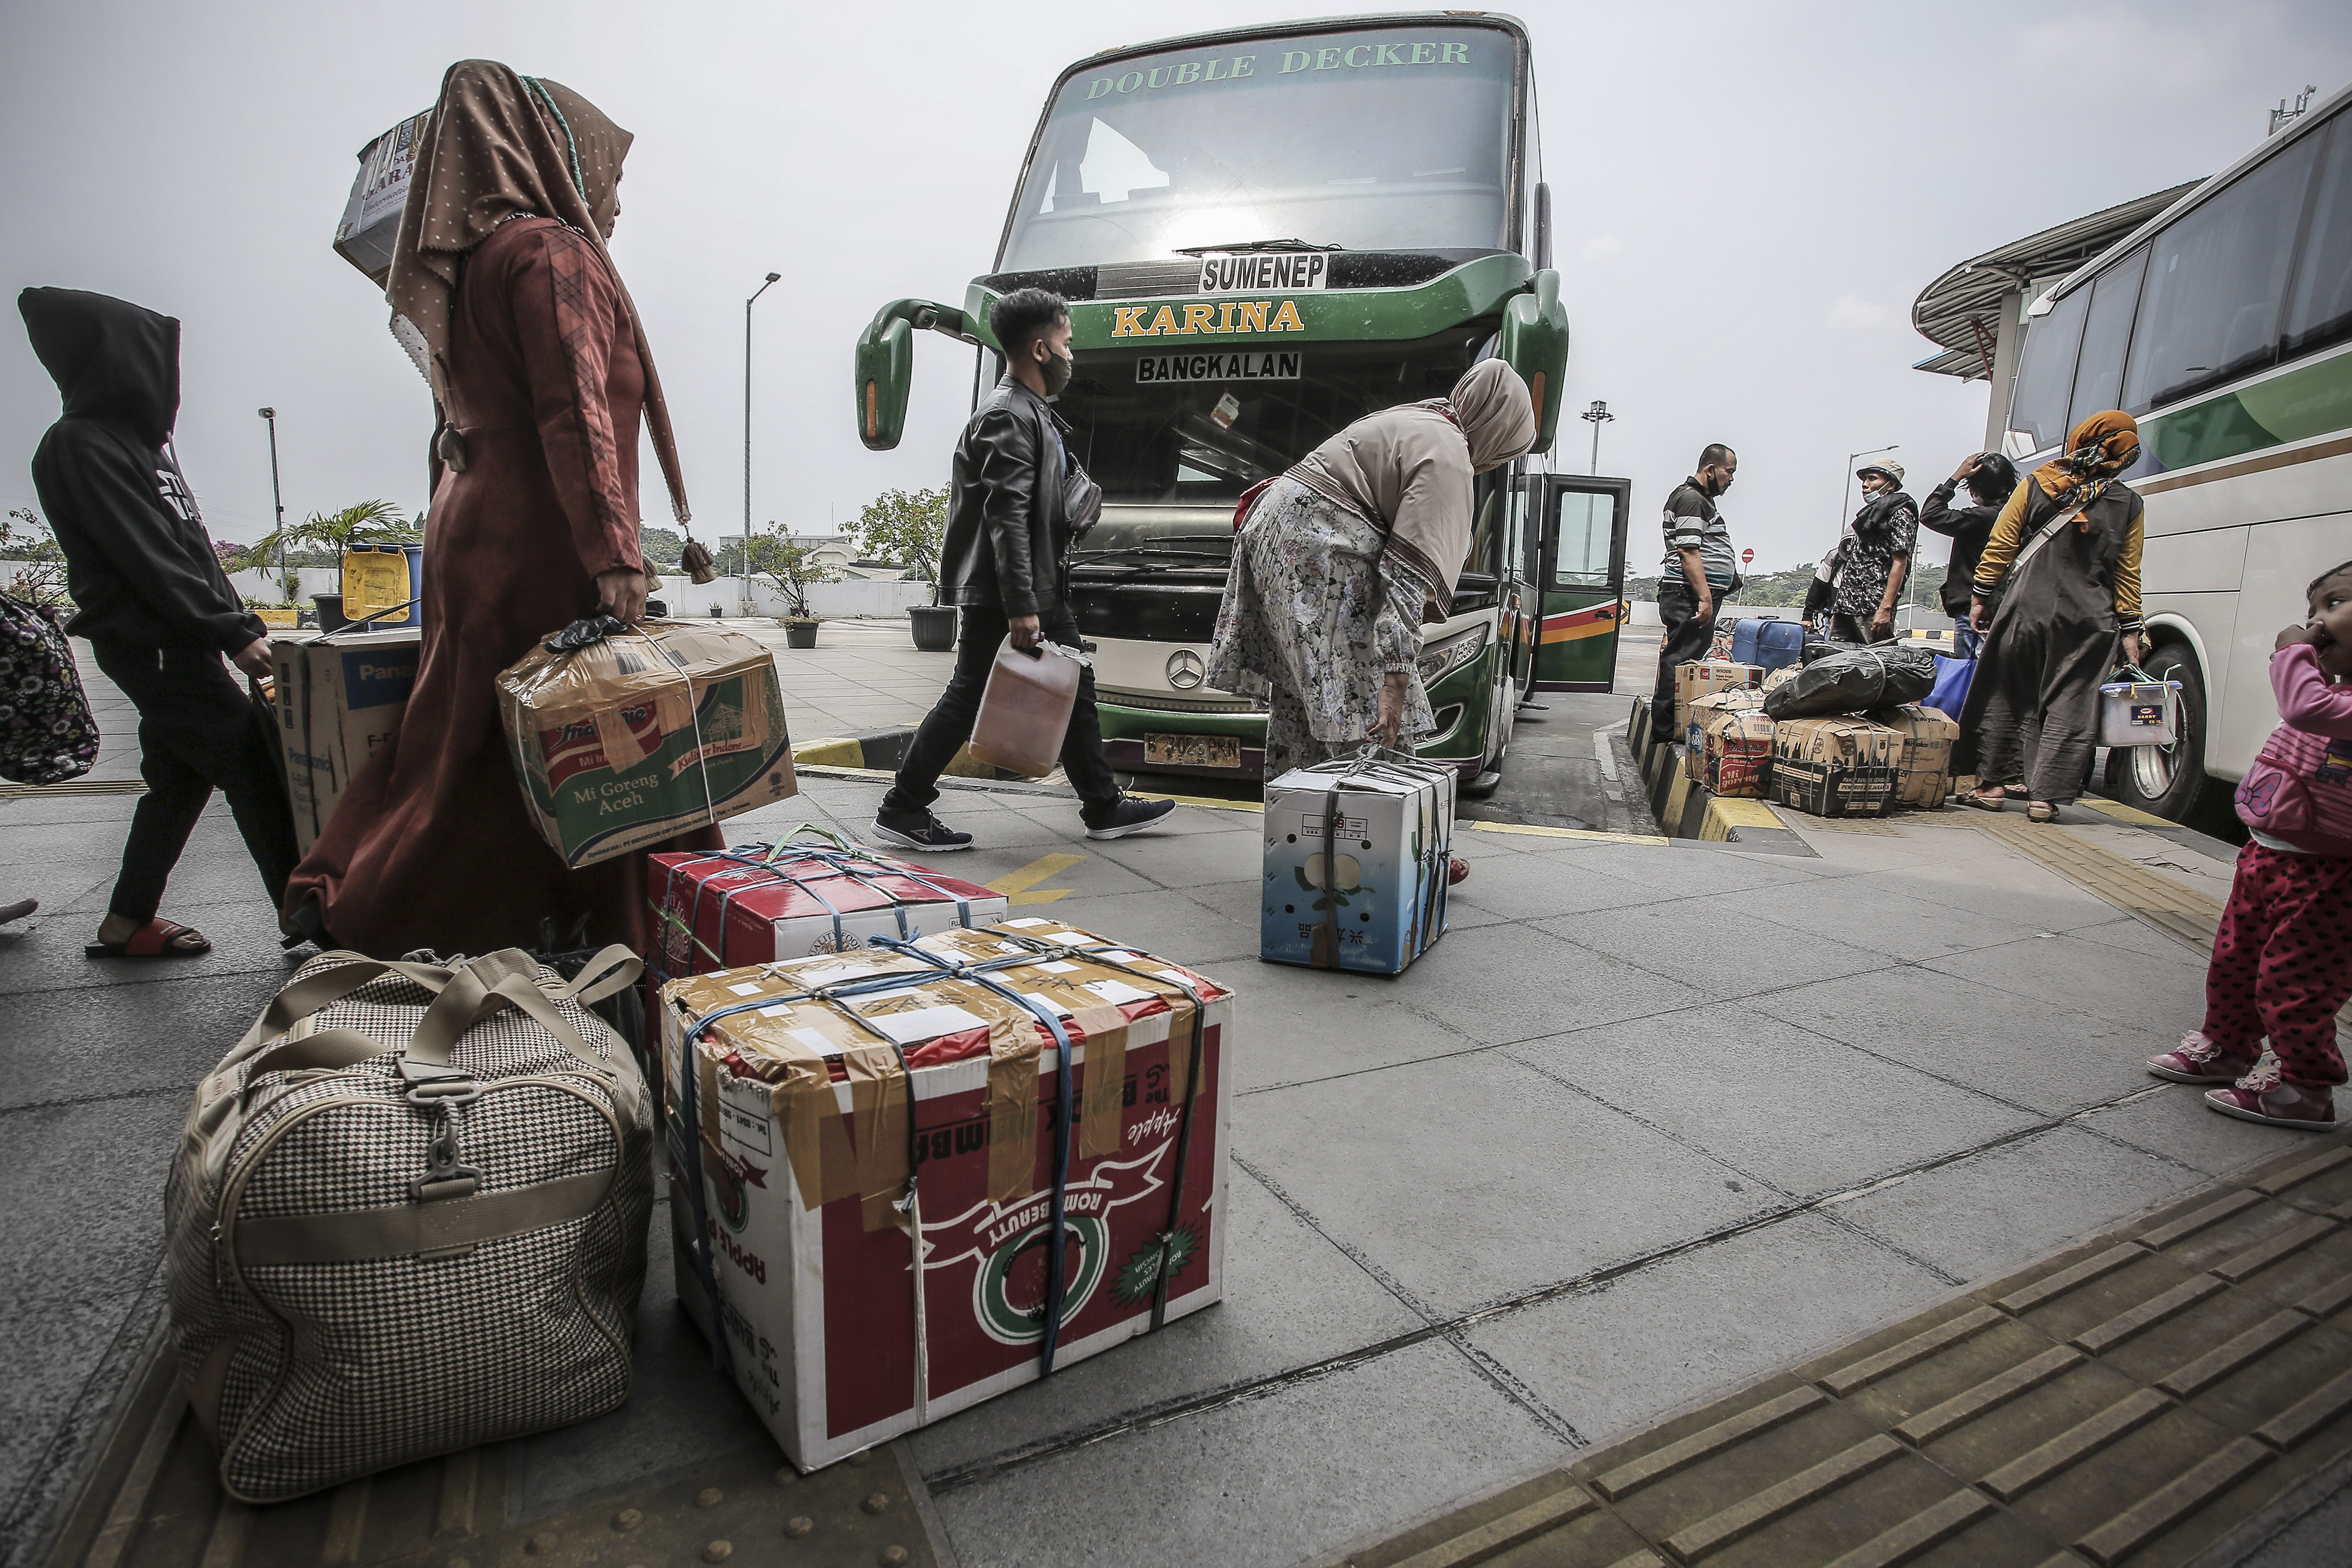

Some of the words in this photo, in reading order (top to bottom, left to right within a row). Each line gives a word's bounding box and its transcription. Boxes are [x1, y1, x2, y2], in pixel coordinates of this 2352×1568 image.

[359, 75, 417, 93] Pana
[1085, 55, 1257, 101] DOUBLE
[1278, 43, 1471, 74] DECKER
[1202, 255, 1324, 291] SUMENEP
[1111, 300, 1305, 337] KARINA
[1138, 353, 1299, 382] BANGKALAN
[712, 740, 754, 755] Indone
[1148, 735, 1156, 752] B
[1209, 738, 1237, 757] PRN
[579, 755, 594, 767] Mi
[573, 787, 597, 804] Mi
[600, 774, 659, 797] Goreng
[599, 791, 644, 816] Aceh
[692, 814, 716, 826] MAKMR
[809, 931, 838, 956] UALITY
[1297, 922, 1364, 945] 兴品
[1145, 1087, 1170, 1104] The
[1127, 1107, 1181, 1146] Apple
[1063, 1193, 1102, 1212] ROM
[988, 1201, 1050, 1248] BEAUTY
[719, 1225, 766, 1285] APPLE
[1135, 1249, 1162, 1273] ONESIA
[1168, 1250, 1182, 1265] RO
[1135, 1272, 1157, 1293] EAUTY
